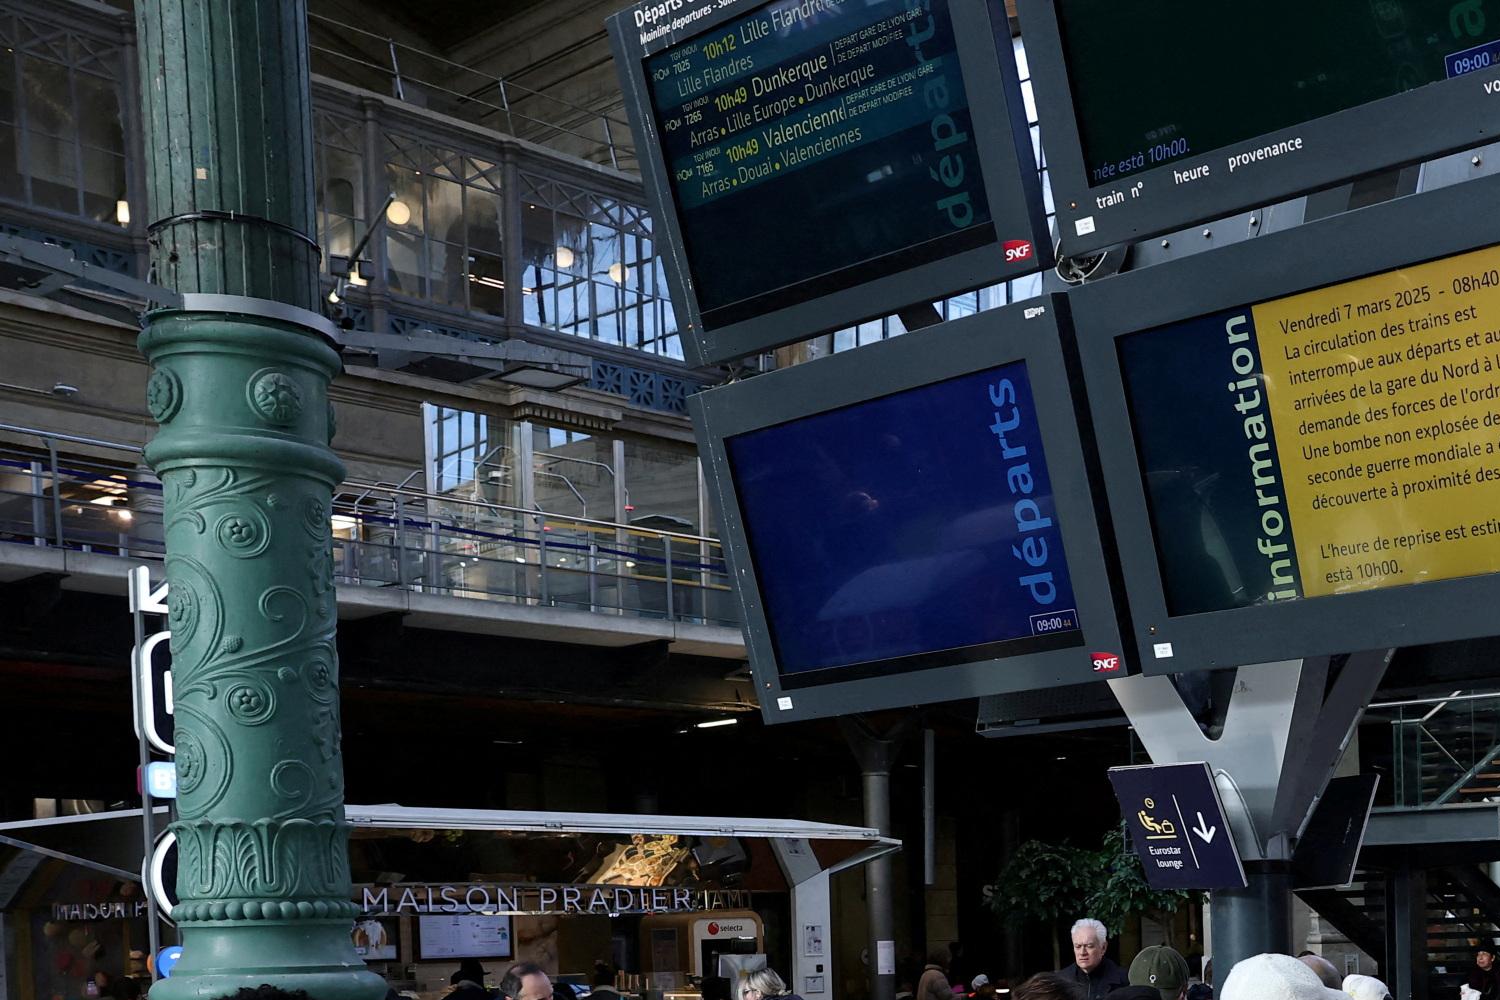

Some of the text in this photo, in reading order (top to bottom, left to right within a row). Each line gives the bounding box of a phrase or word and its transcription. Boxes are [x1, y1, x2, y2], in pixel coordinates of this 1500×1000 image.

[634, 0, 683, 27] Départs
[640, 23, 671, 45] Mainline
[672, 5, 712, 30] departures
[703, 34, 737, 60] 10h12
[740, 20, 769, 45] Lille
[835, 35, 859, 50] DEPART
[859, 26, 876, 40] GARE
[877, 21, 887, 33] DE
[837, 29, 904, 63] DE DEPART MODIFIEE
[672, 59, 691, 75] 7025
[677, 56, 754, 97] Lille Flandres
[1454, 52, 1490, 74] 09:00
[714, 55, 827, 112] 10h49 Dunkerque
[846, 64, 934, 104] DEPART GARE DE GARE
[849, 86, 913, 117] DE DEPART MODIFIEE
[684, 110, 703, 126] 7265
[690, 64, 876, 148] Arras Lille Europe Dunkerque
[696, 161, 714, 176] 7165
[702, 128, 862, 198] Arras Douai Valenciennes
[726, 138, 759, 163] 10h49
[1118, 138, 1190, 173] està 10h00.
[1096, 134, 1303, 208] train n° heure provenance
[1005, 243, 1030, 261] SNCF
[1279, 308, 1341, 335] Vendredi
[1344, 304, 1354, 321] 7
[1357, 298, 1392, 317] mars
[1394, 285, 1431, 310] 2025
[1452, 269, 1500, 296] 08h40
[1283, 305, 1478, 361] La circulation des trains est
[1289, 353, 1375, 386] interrompue
[1377, 350, 1404, 367] aux
[1406, 334, 1461, 364] départs
[1465, 329, 1481, 346] et
[1294, 386, 1346, 411] arrivées
[1349, 381, 1366, 401] de
[1369, 377, 1383, 396] la
[1386, 374, 1417, 397] gare
[1420, 366, 1438, 386] du
[1442, 357, 1480, 381] Nord
[1483, 356, 1492, 373] à
[1298, 410, 1361, 437] demande
[1364, 406, 1389, 424] des
[1391, 395, 1436, 418] forces
[1439, 391, 1457, 410] de
[1302, 443, 1330, 462] Une
[1333, 433, 1381, 456] bombe
[1384, 429, 1411, 446] non
[1414, 417, 1479, 447] explosée
[1483, 411, 1500, 430] de
[1225, 313, 1300, 604] information
[1307, 463, 1363, 487] seconde
[1366, 456, 1410, 480] guerre
[1414, 442, 1482, 469] mondiale
[1485, 443, 1494, 454] a
[989, 377, 1057, 605] départs
[1312, 484, 1388, 511] découverte
[1391, 480, 1399, 498] à
[1403, 470, 1471, 500] proximité
[1475, 465, 1500, 484] des
[1320, 540, 1369, 560] L'heure
[1373, 535, 1391, 553] de
[1394, 528, 1441, 554] reprise
[1445, 524, 1468, 541] est
[1325, 558, 1404, 585] està 10h00.
[1036, 616, 1063, 632] 09:00
[1092, 655, 1118, 670] SNCF
[1149, 846, 1182, 856] Eurostar
[1156, 858, 1183, 869] lounge
[363, 886, 518, 912] MAISON
[540, 887, 691, 912] PRADIER
[720, 924, 743, 932] selecta
